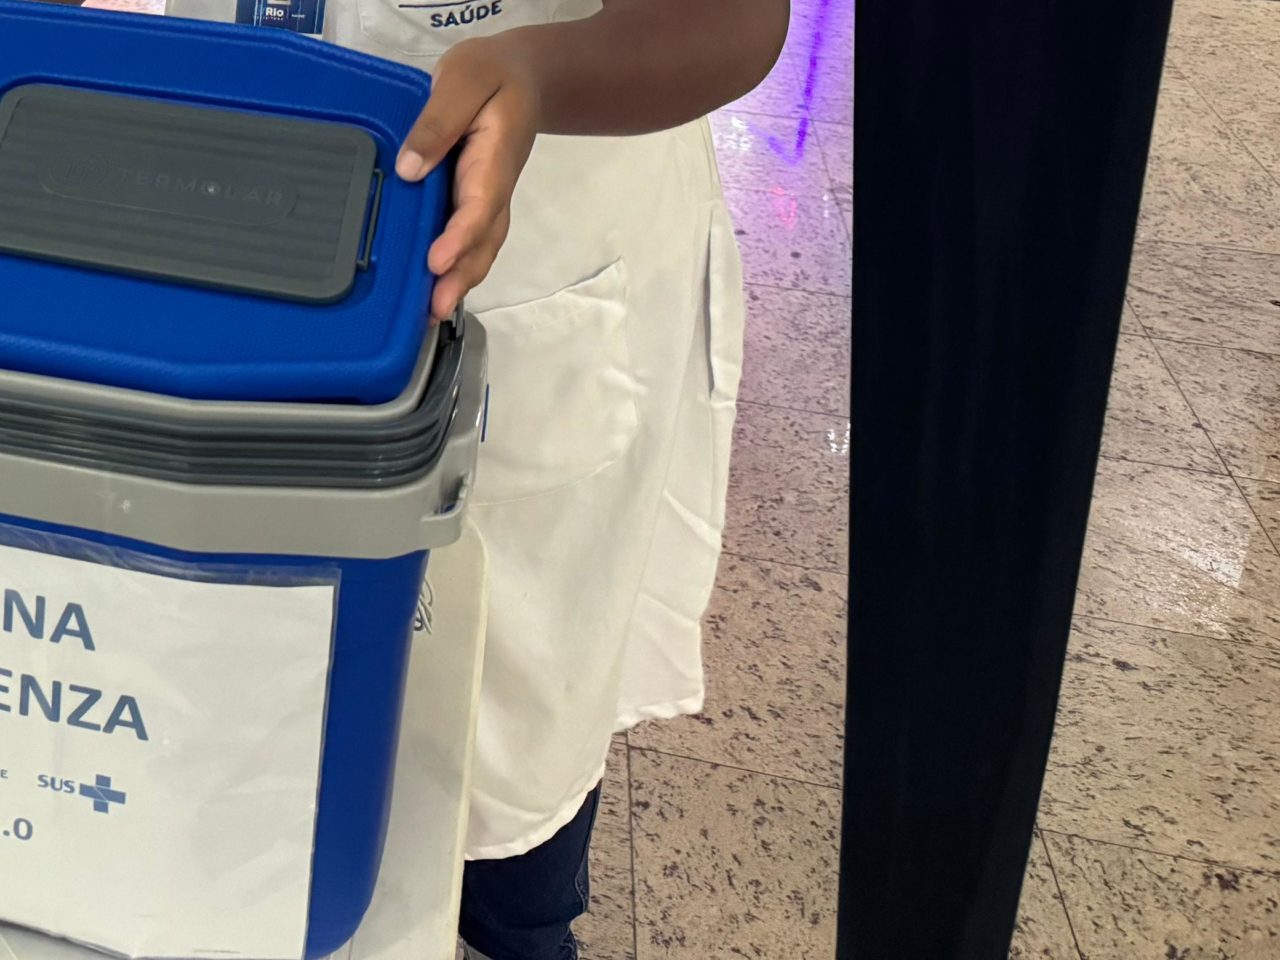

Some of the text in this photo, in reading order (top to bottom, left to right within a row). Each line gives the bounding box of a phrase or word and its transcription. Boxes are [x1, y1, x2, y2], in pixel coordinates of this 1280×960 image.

[265, 7, 284, 17] Rio
[430, 0, 503, 29] SAÚDE
[37, 773, 76, 794] SUS
